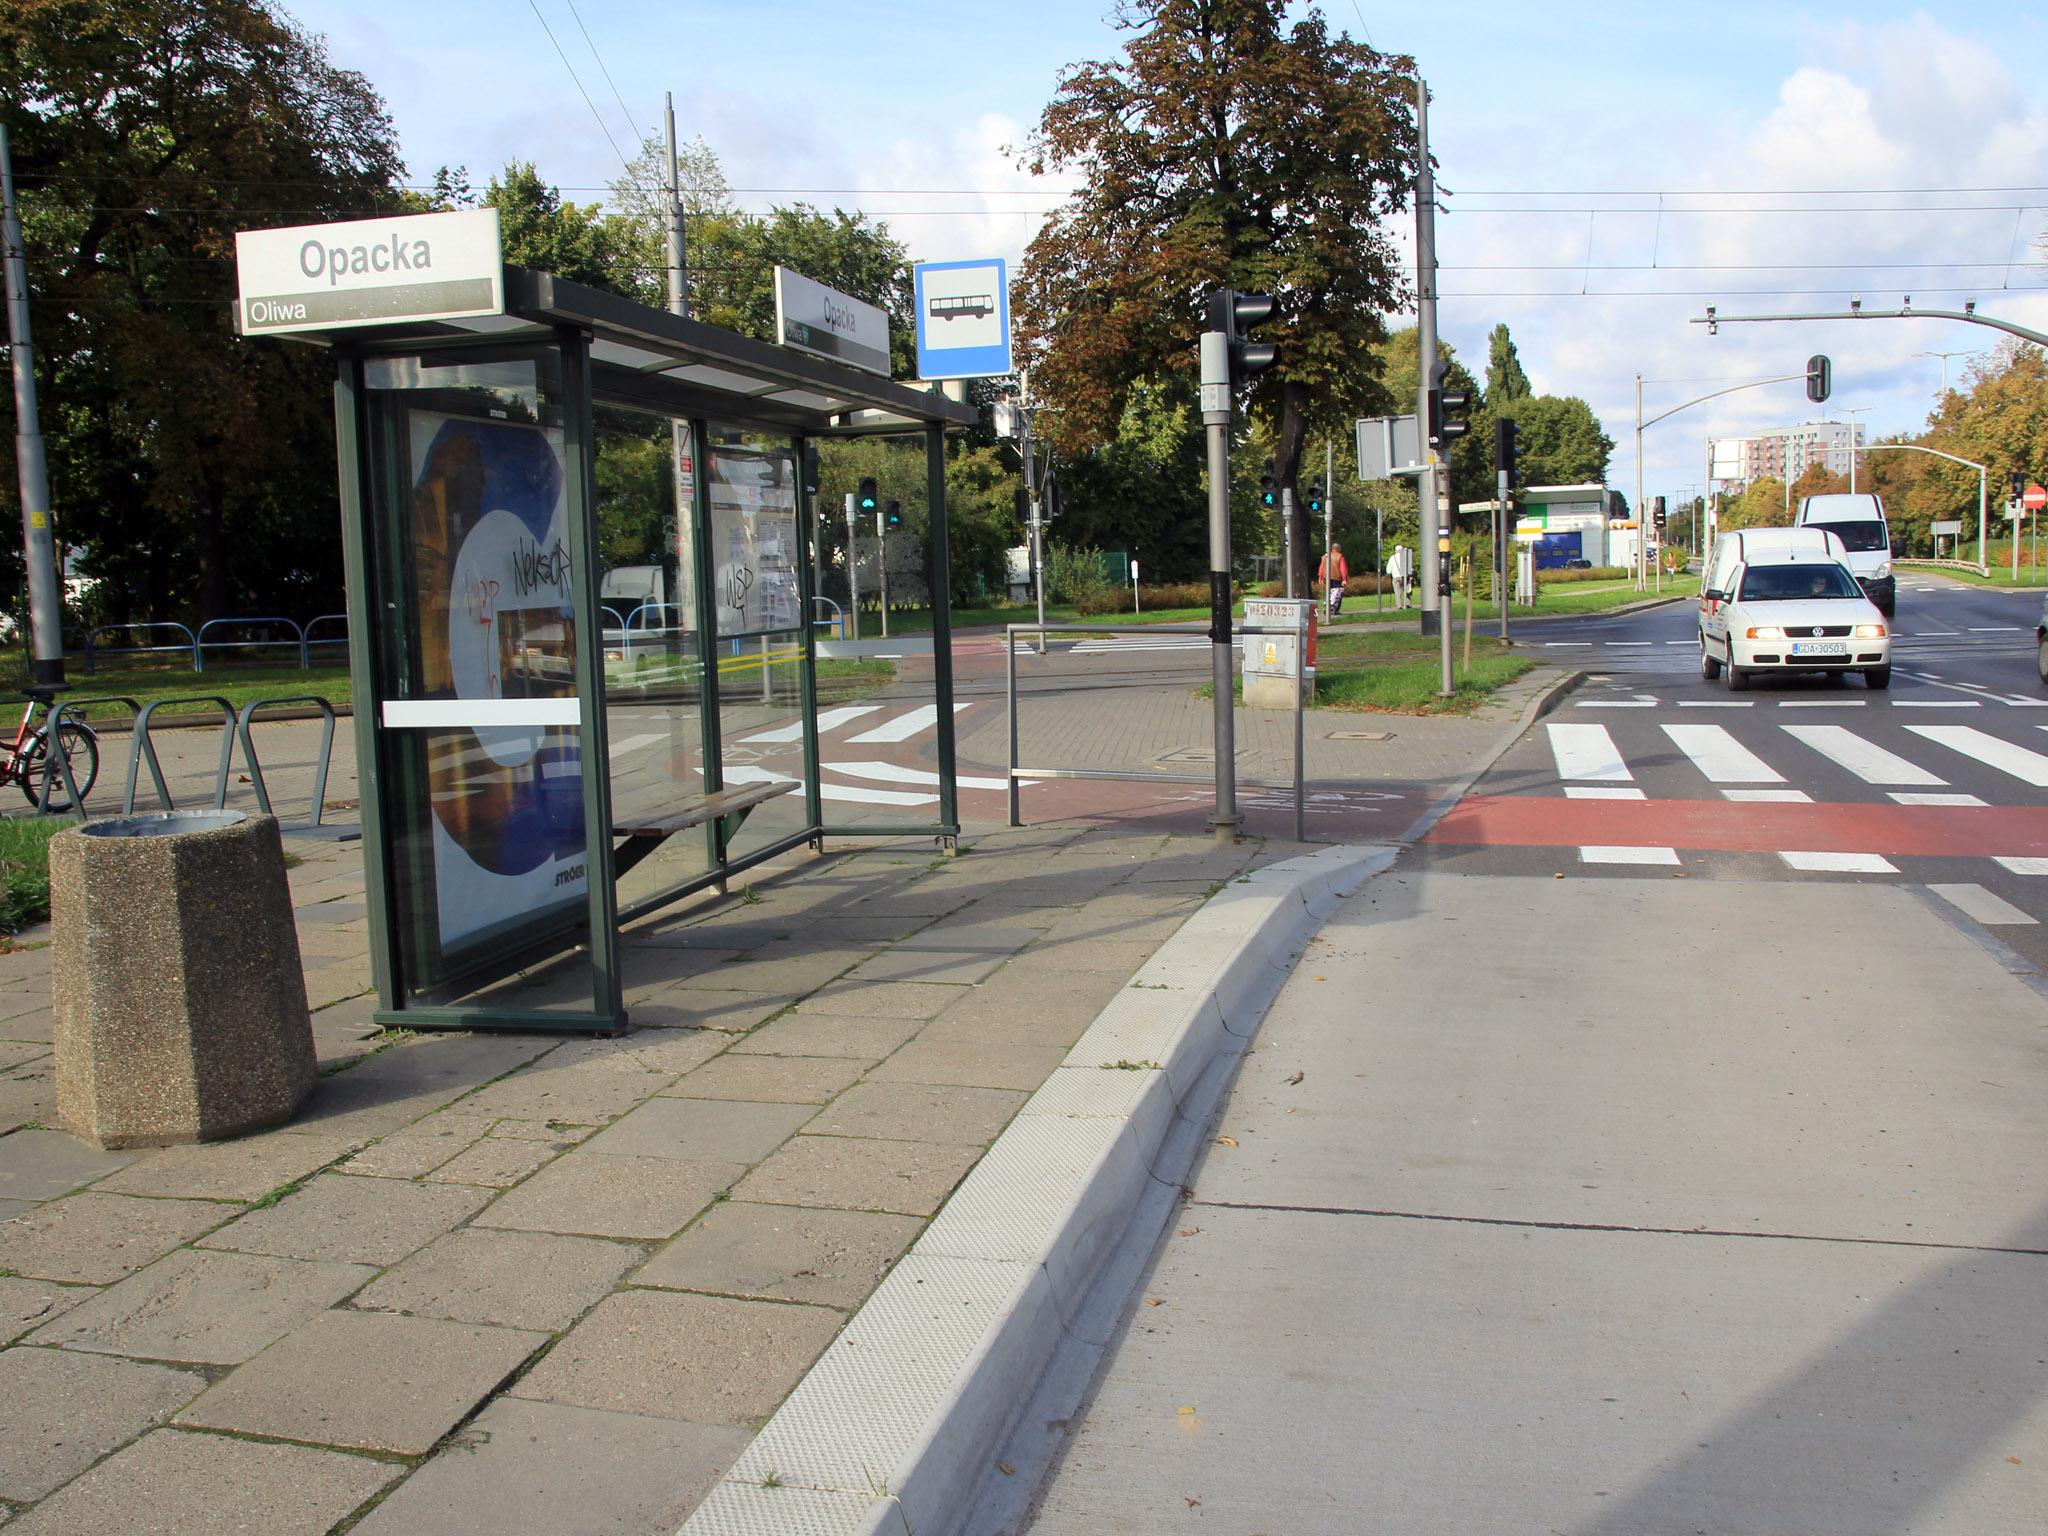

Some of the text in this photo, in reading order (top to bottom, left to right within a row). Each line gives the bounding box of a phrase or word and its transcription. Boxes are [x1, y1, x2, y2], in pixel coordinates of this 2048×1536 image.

[300, 233, 432, 286] Opacka
[251, 302, 307, 323] Oliwa
[824, 296, 856, 333] Opacka
[1799, 644, 1845, 654] GDA 30503
